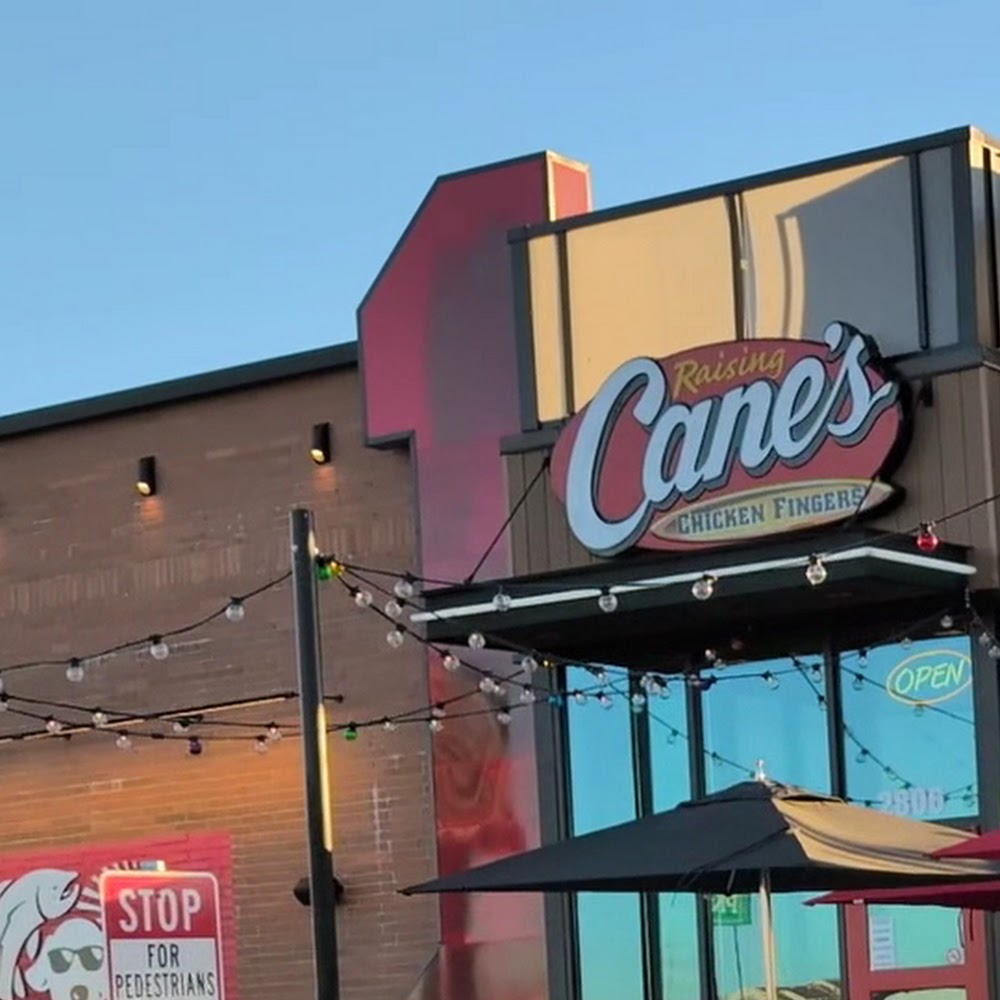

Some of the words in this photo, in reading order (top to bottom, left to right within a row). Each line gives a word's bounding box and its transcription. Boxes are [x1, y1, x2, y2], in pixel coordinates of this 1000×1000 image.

[673, 347, 787, 397] Raising
[566, 321, 896, 555] Cane's
[676, 504, 765, 536] CHICKEN
[773, 485, 865, 520] FINGERS
[894, 659, 965, 695] OPEN
[118, 888, 202, 933] STOP
[147, 943, 181, 969] FOR
[115, 972, 216, 999] PEDESTRIANS
